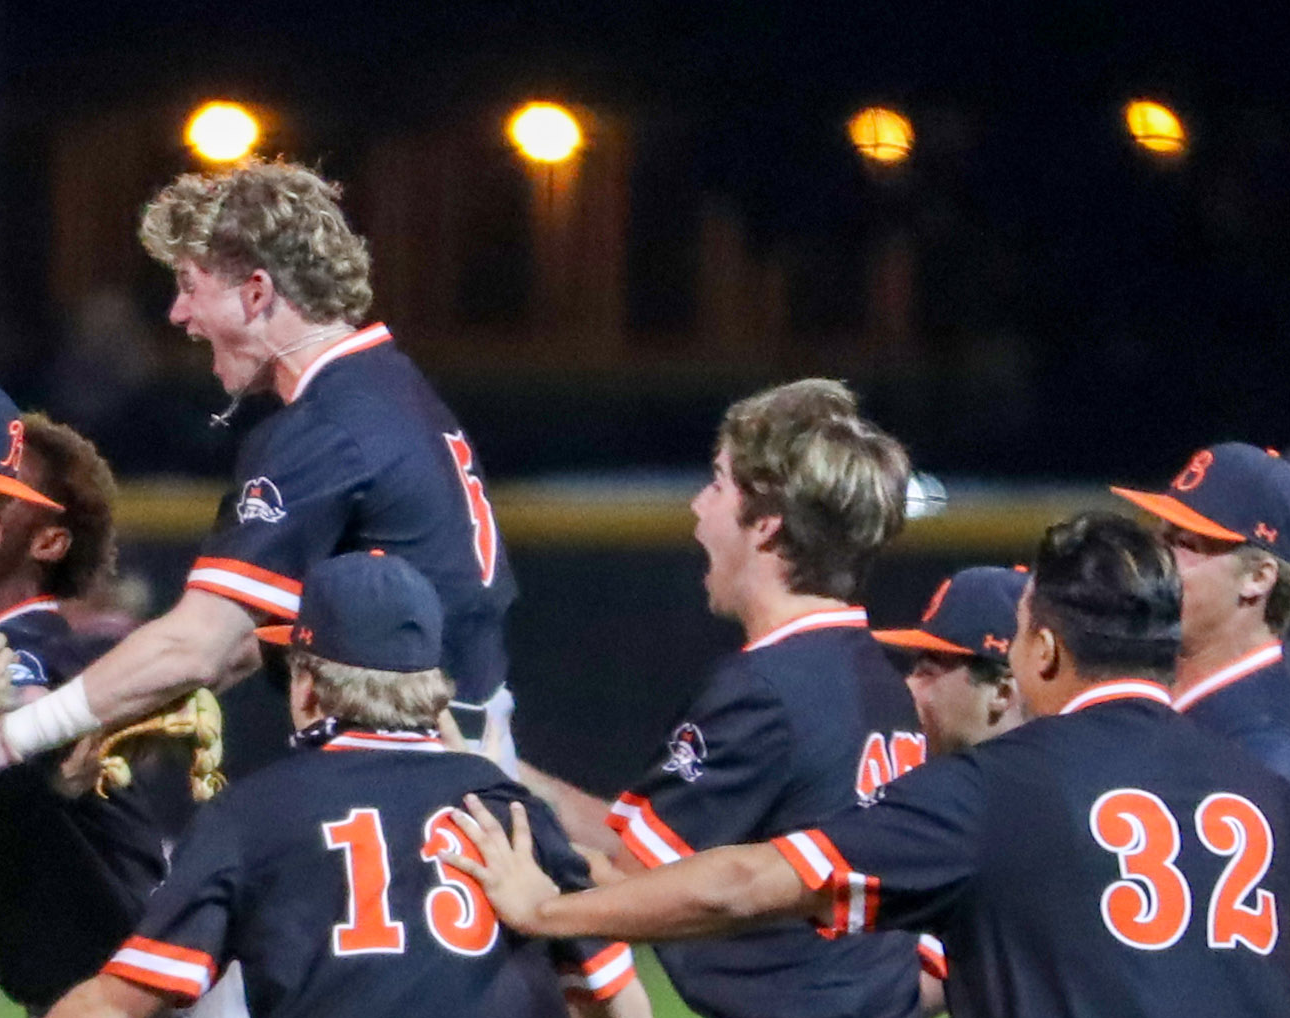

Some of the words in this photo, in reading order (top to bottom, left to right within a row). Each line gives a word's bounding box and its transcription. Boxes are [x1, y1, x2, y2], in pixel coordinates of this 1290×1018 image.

[1172, 450, 1213, 491] B
[321, 806, 500, 957] 13
[1089, 788, 1279, 956] 32
